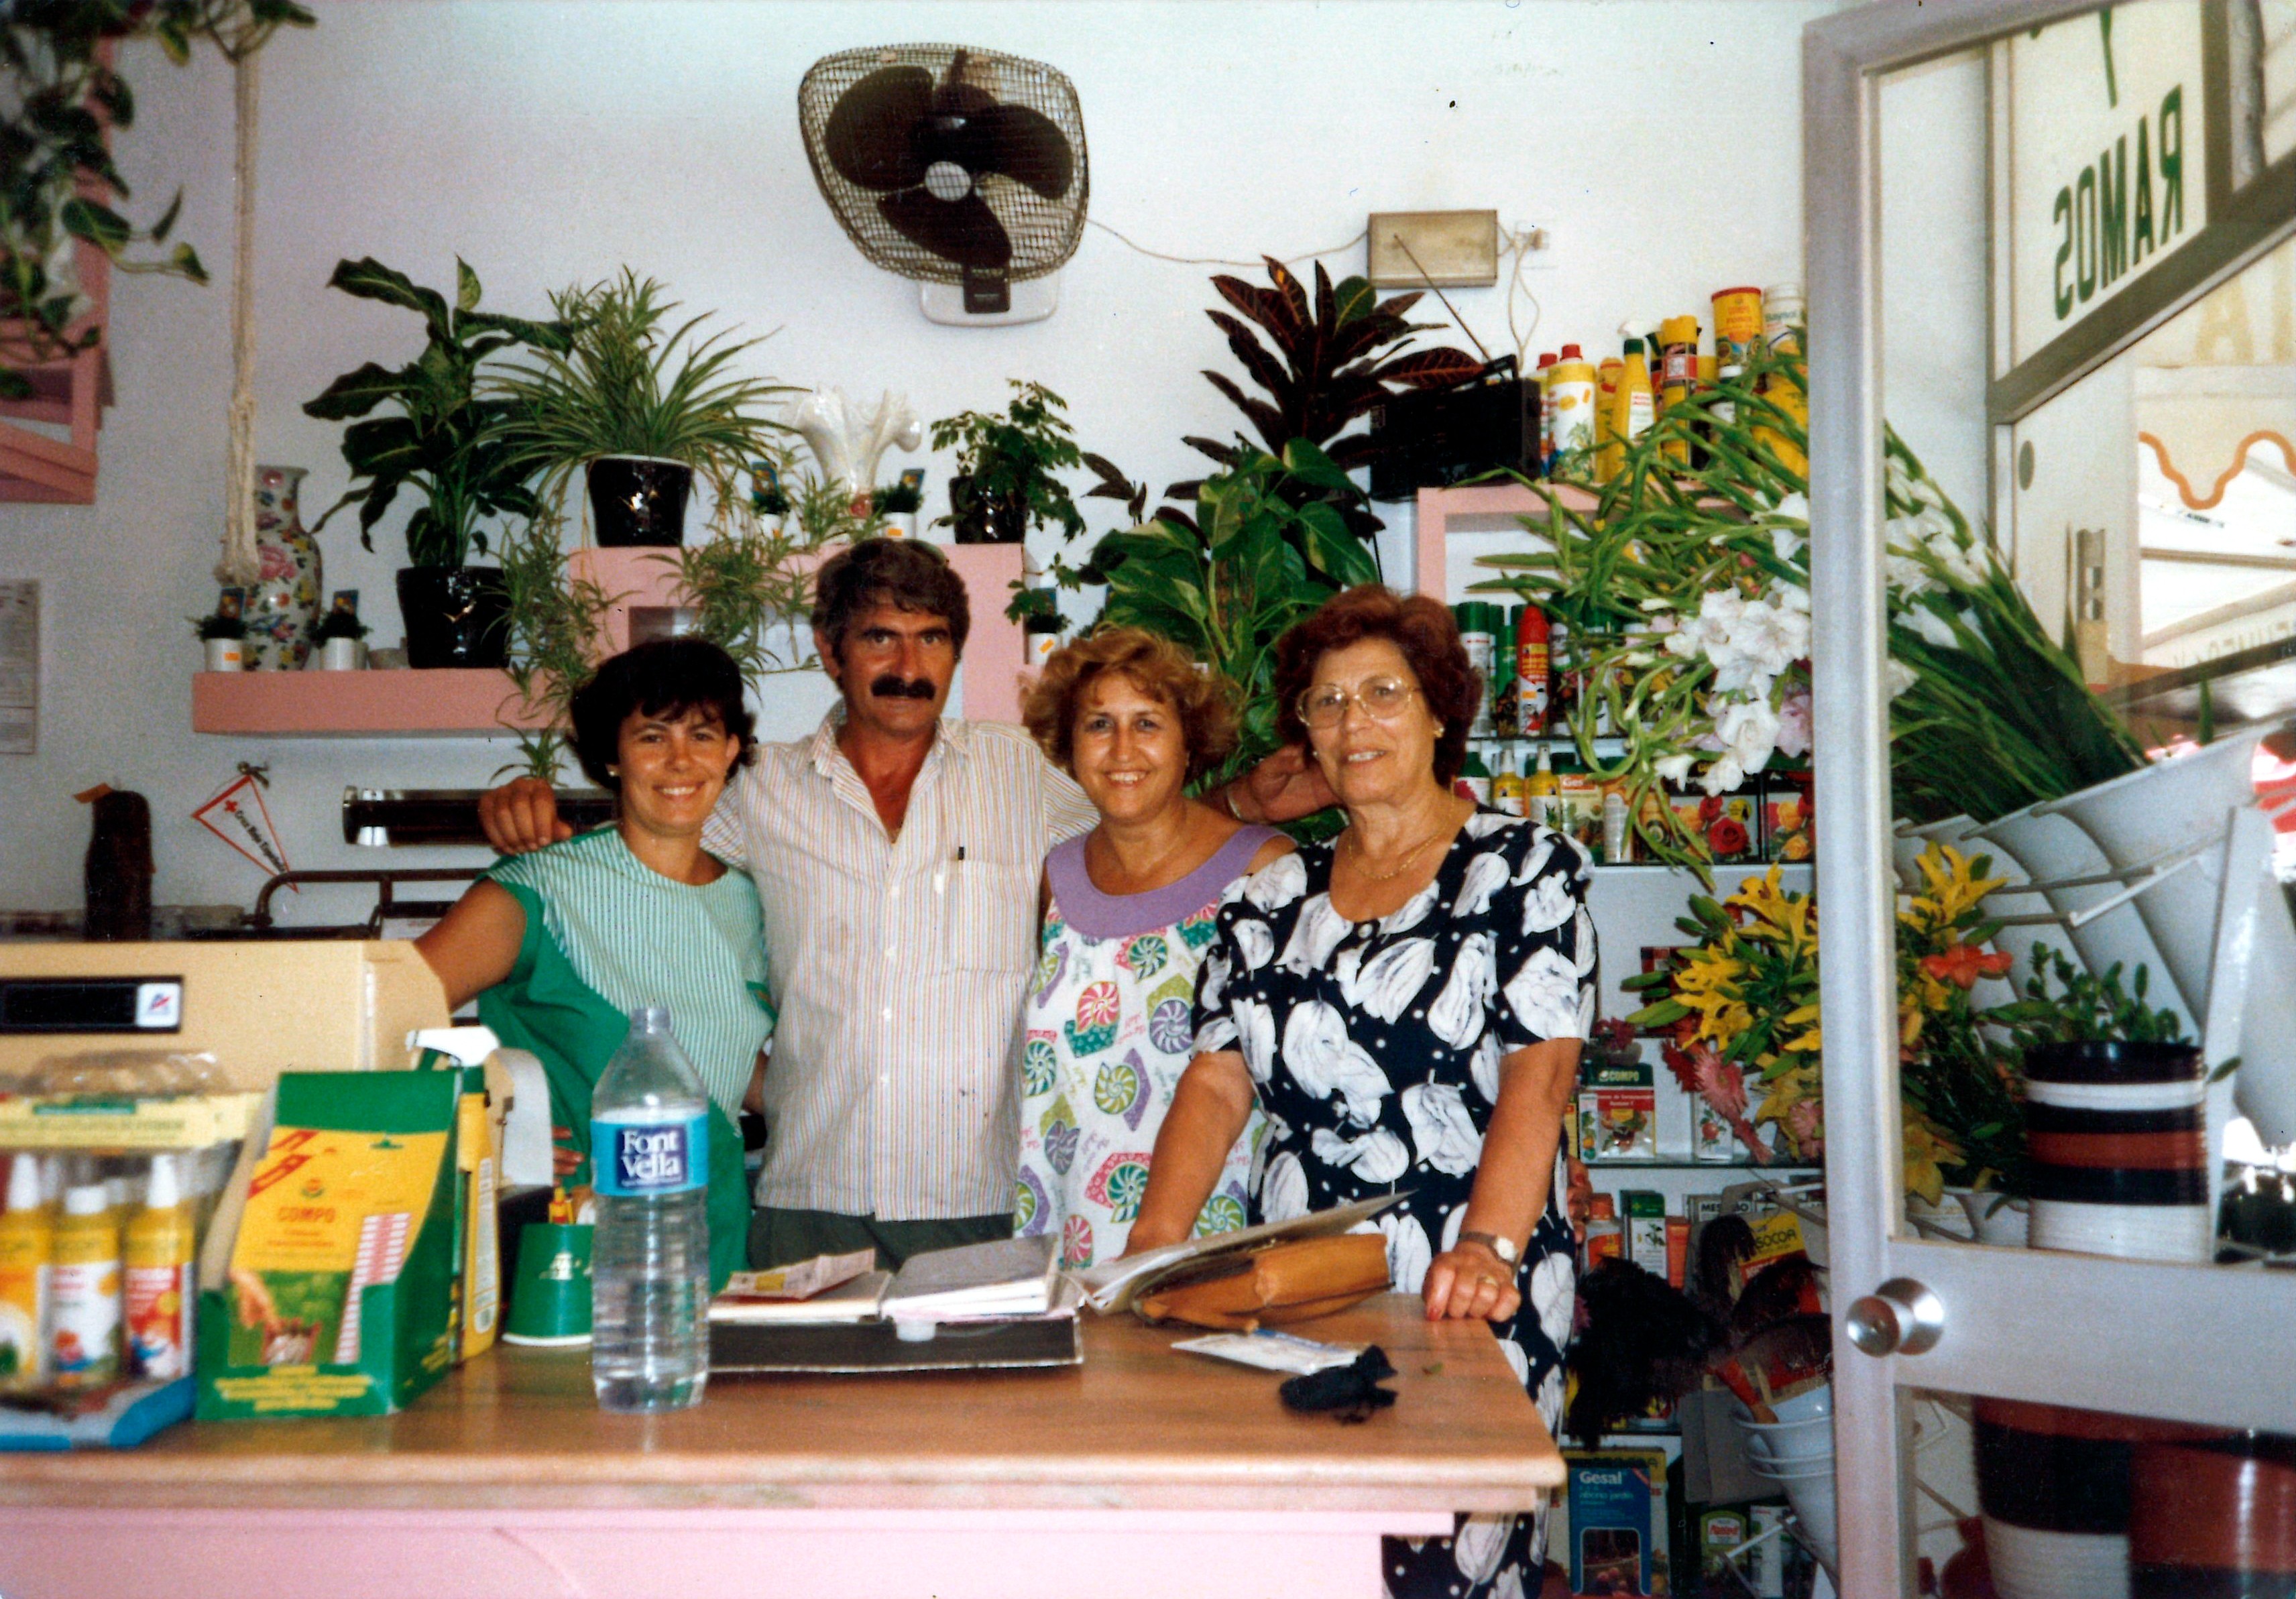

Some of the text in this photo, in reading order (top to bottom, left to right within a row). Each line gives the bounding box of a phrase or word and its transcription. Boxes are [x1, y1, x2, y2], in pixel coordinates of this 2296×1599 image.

[623, 1130, 679, 1154] Font
[621, 1152, 681, 1179] Vella
[278, 1206, 335, 1224] COMPO
[1579, 1470, 1623, 1484] Gesal
